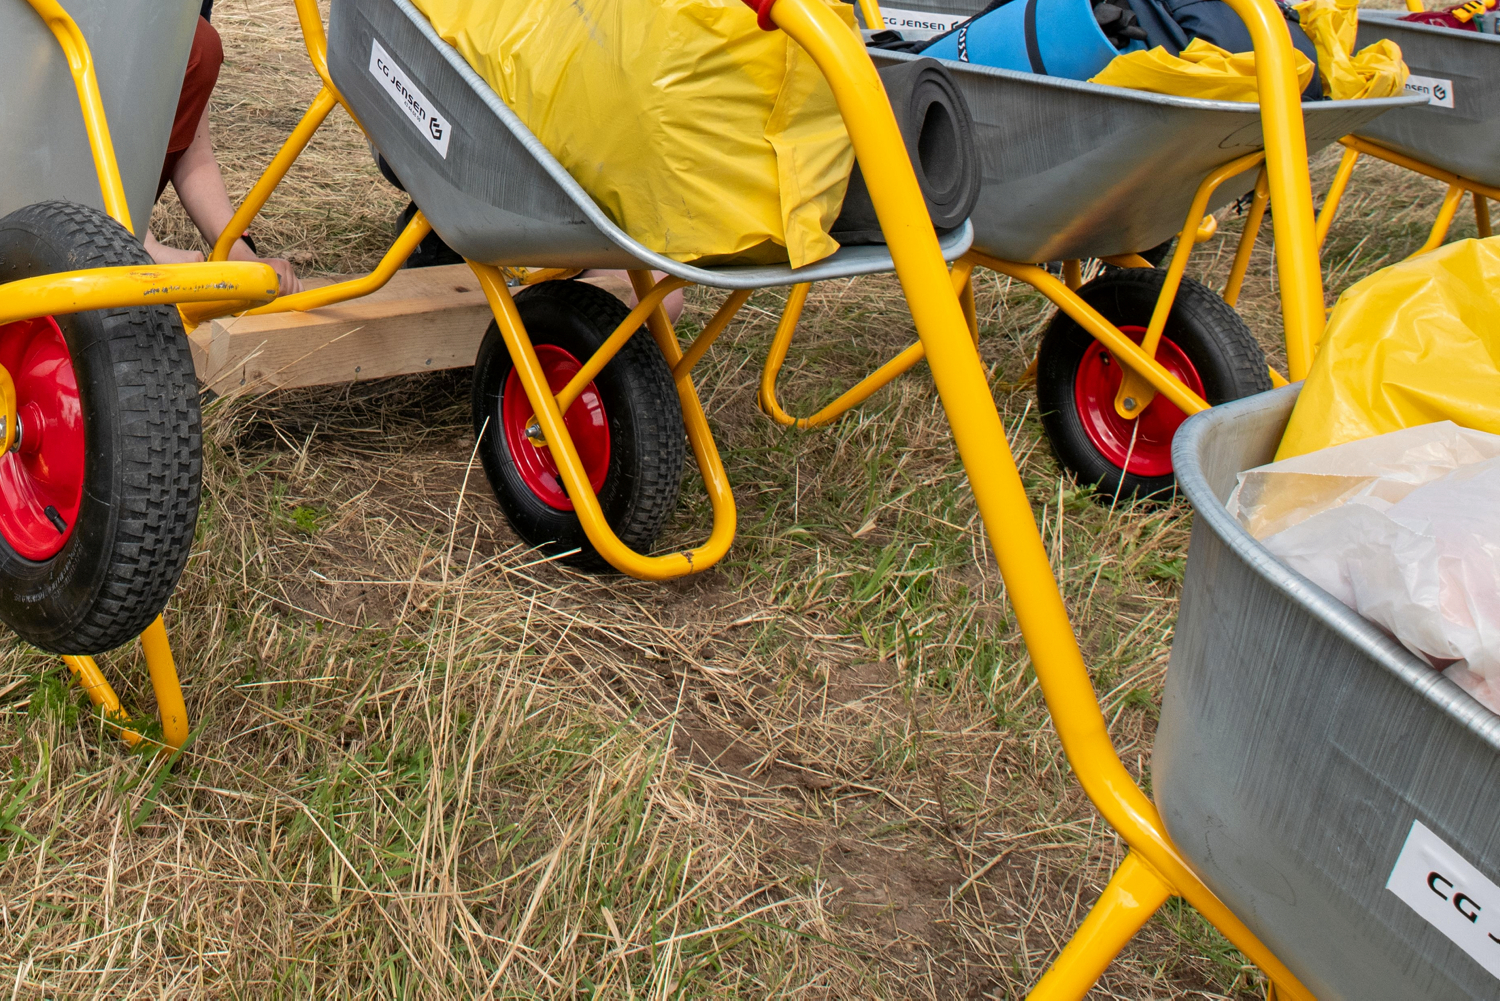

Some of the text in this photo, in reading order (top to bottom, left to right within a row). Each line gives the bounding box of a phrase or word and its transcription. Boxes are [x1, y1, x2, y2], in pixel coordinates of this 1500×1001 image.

[883, 16, 945, 31] CG JENSEN
[376, 58, 426, 121] CG JENSEN
[1427, 871, 1482, 924] CG
